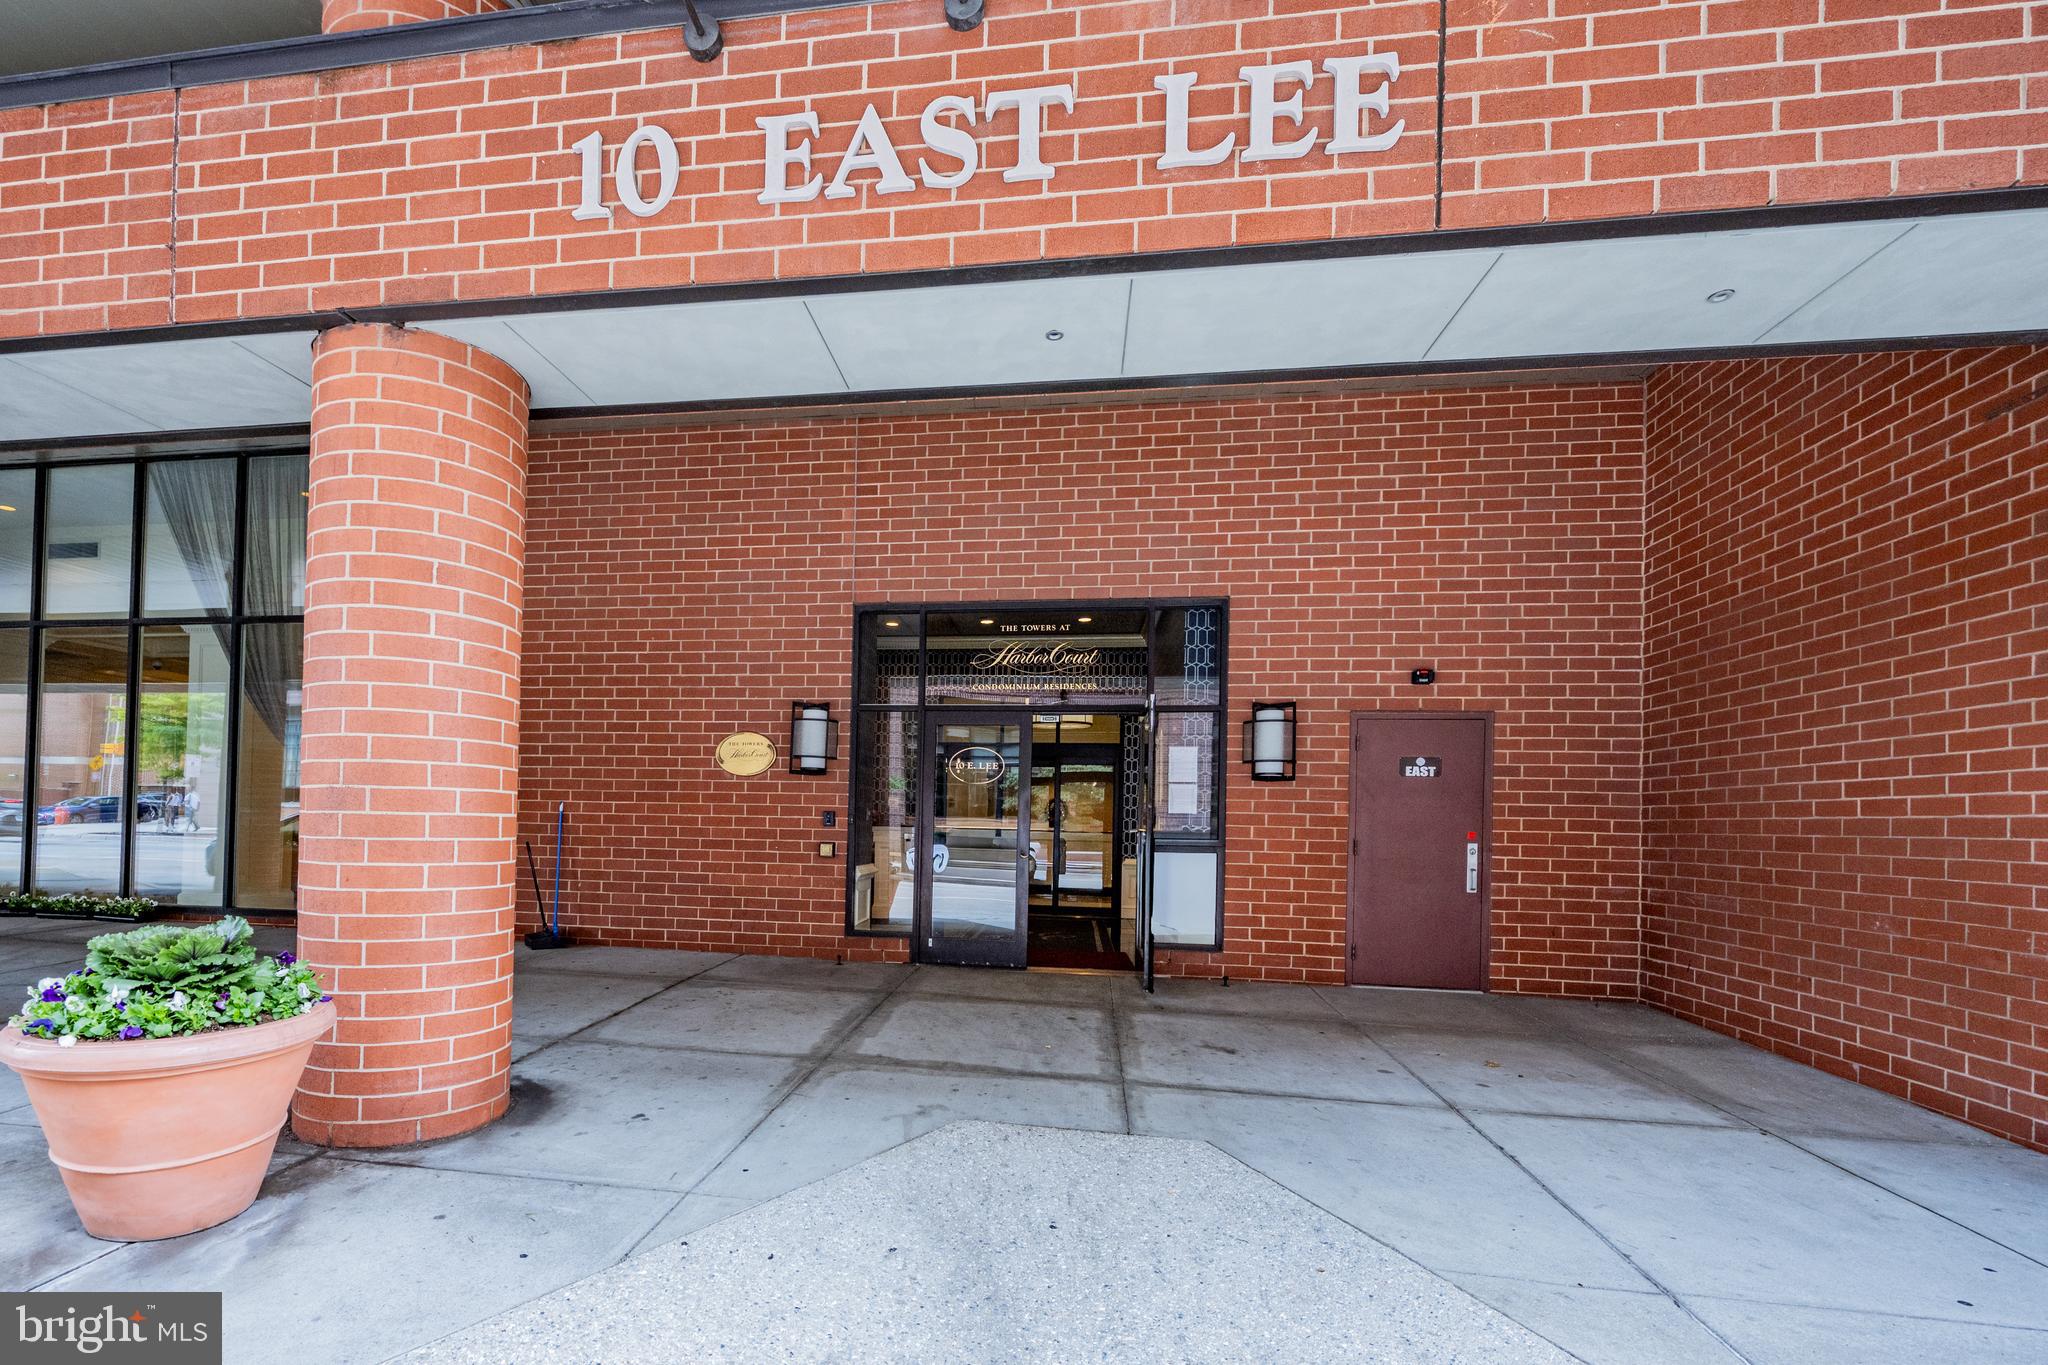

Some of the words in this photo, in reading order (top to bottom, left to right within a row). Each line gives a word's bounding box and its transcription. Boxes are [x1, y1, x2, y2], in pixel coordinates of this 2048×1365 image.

[571, 123, 681, 221] 10
[754, 83, 1075, 205] EAST
[1153, 50, 1406, 171] LEE
[1021, 624, 1056, 632] TOWERS
[972, 683, 1040, 691] CONDOMINIUM
[1044, 682, 1098, 690] RESIDENCES
[967, 762, 976, 770] E.
[979, 762, 999, 770] LEE
[1405, 766, 1436, 777] EAST
